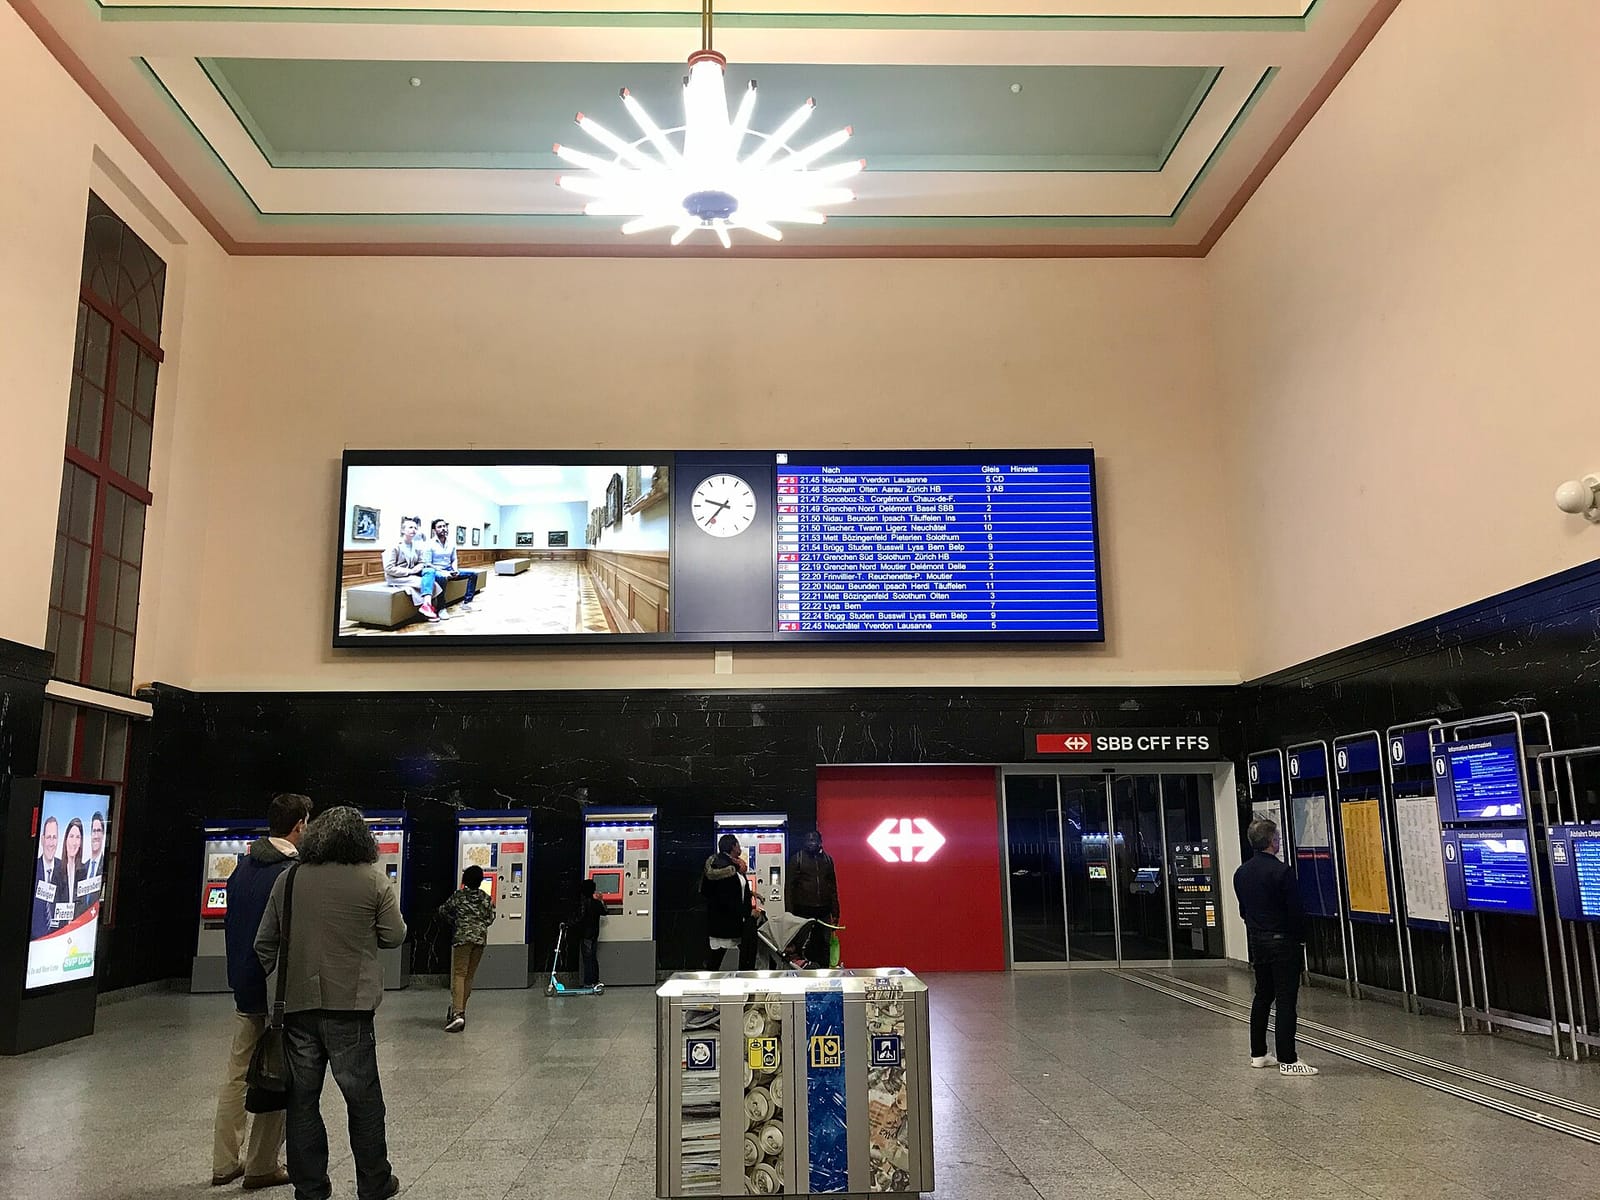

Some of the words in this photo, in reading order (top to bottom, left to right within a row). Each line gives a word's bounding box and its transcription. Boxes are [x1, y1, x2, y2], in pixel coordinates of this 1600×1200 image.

[1096, 736, 1133, 750] SBB
[1137, 736, 1170, 750] CFF
[1176, 736, 1210, 750] FFS
[56, 908, 74, 919] Pieren
